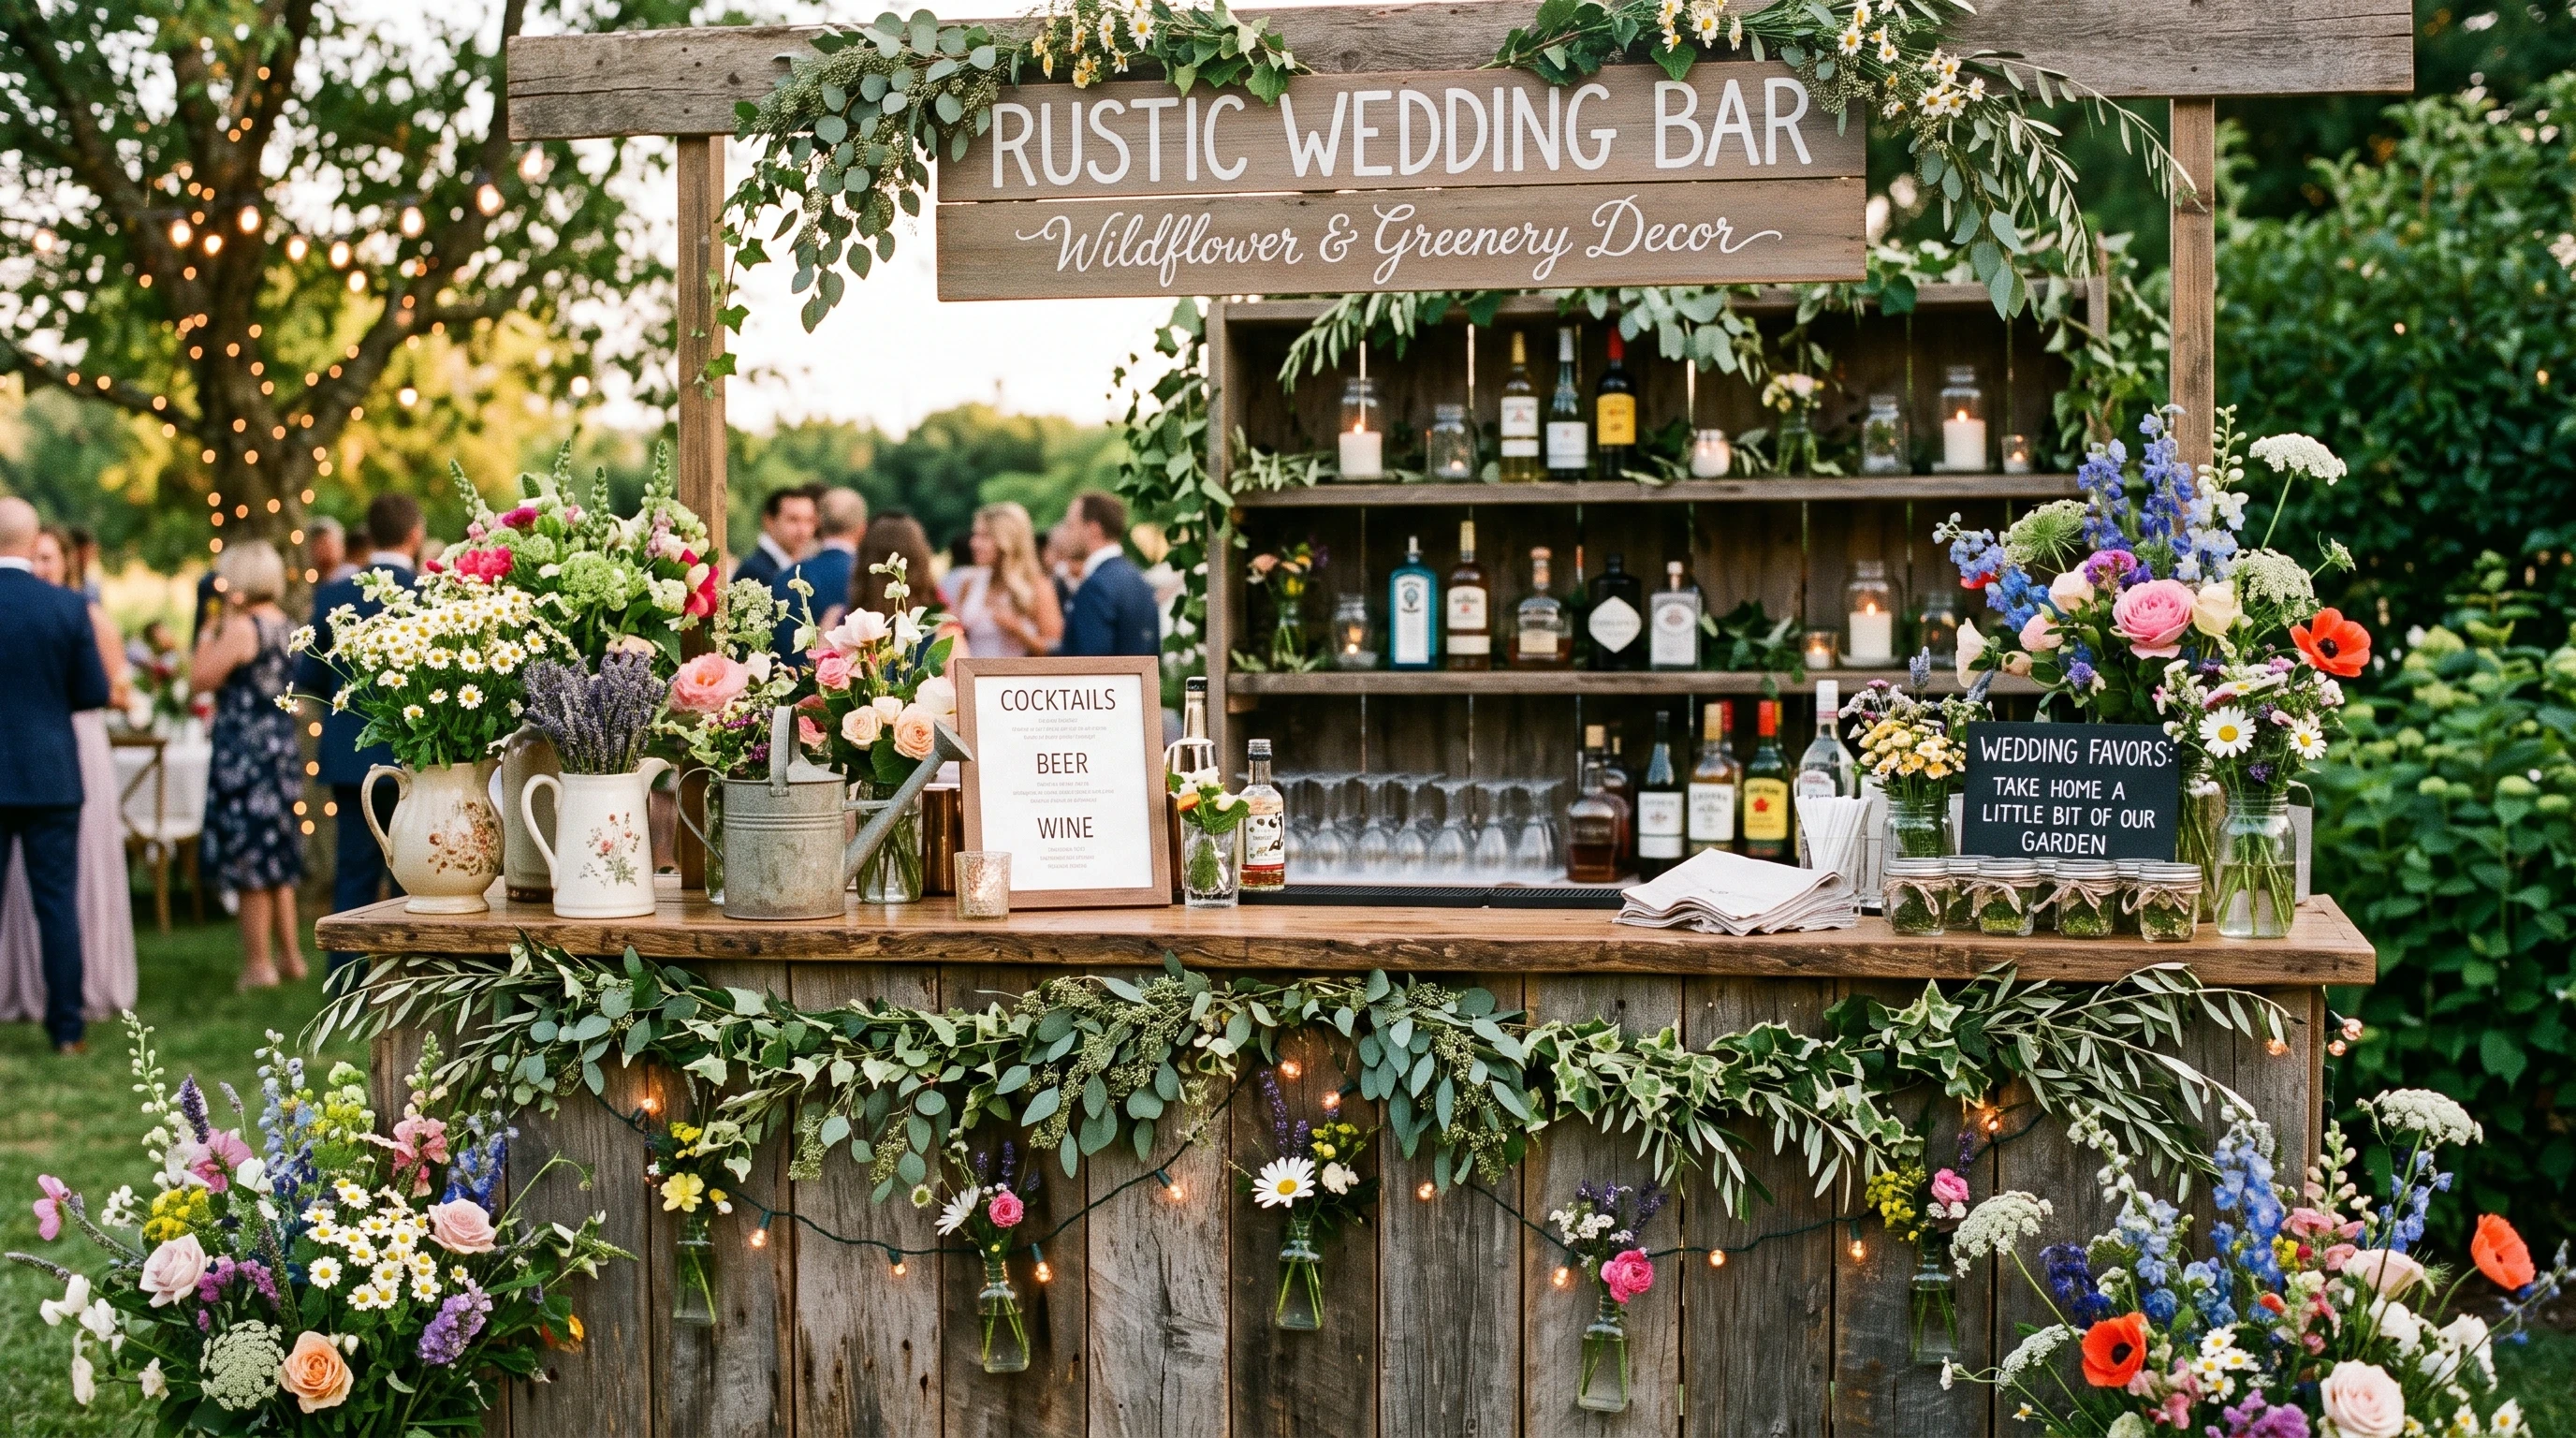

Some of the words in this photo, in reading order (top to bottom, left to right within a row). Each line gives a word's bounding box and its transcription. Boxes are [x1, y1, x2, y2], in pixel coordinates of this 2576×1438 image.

[993, 95, 1247, 187] RUSTIC
[1281, 84, 1617, 177] WEDDING
[1655, 78, 1811, 169] BAR
[1016, 213, 1303, 287] Wildflower
[1320, 213, 1357, 262] &
[1373, 204, 1573, 285] Greenery
[1586, 195, 1782, 257] Decor
[1002, 689, 1115, 711] COCKTAILS
[1037, 753, 1088, 773] BEER
[1981, 737, 2077, 764] WEDDING
[2089, 739, 2174, 767] FAVORS:
[1993, 777, 2039, 797] TAKE
[2051, 780, 2101, 799] HOME
[2112, 782, 2125, 800] A
[1038, 817, 1093, 839] WINE
[1983, 804, 2043, 823] LITTLE
[2054, 806, 2082, 825] BIT
[2091, 808, 2112, 826] OF
[2121, 810, 2155, 829] OUR
[2022, 831, 2106, 855] GARDEN
